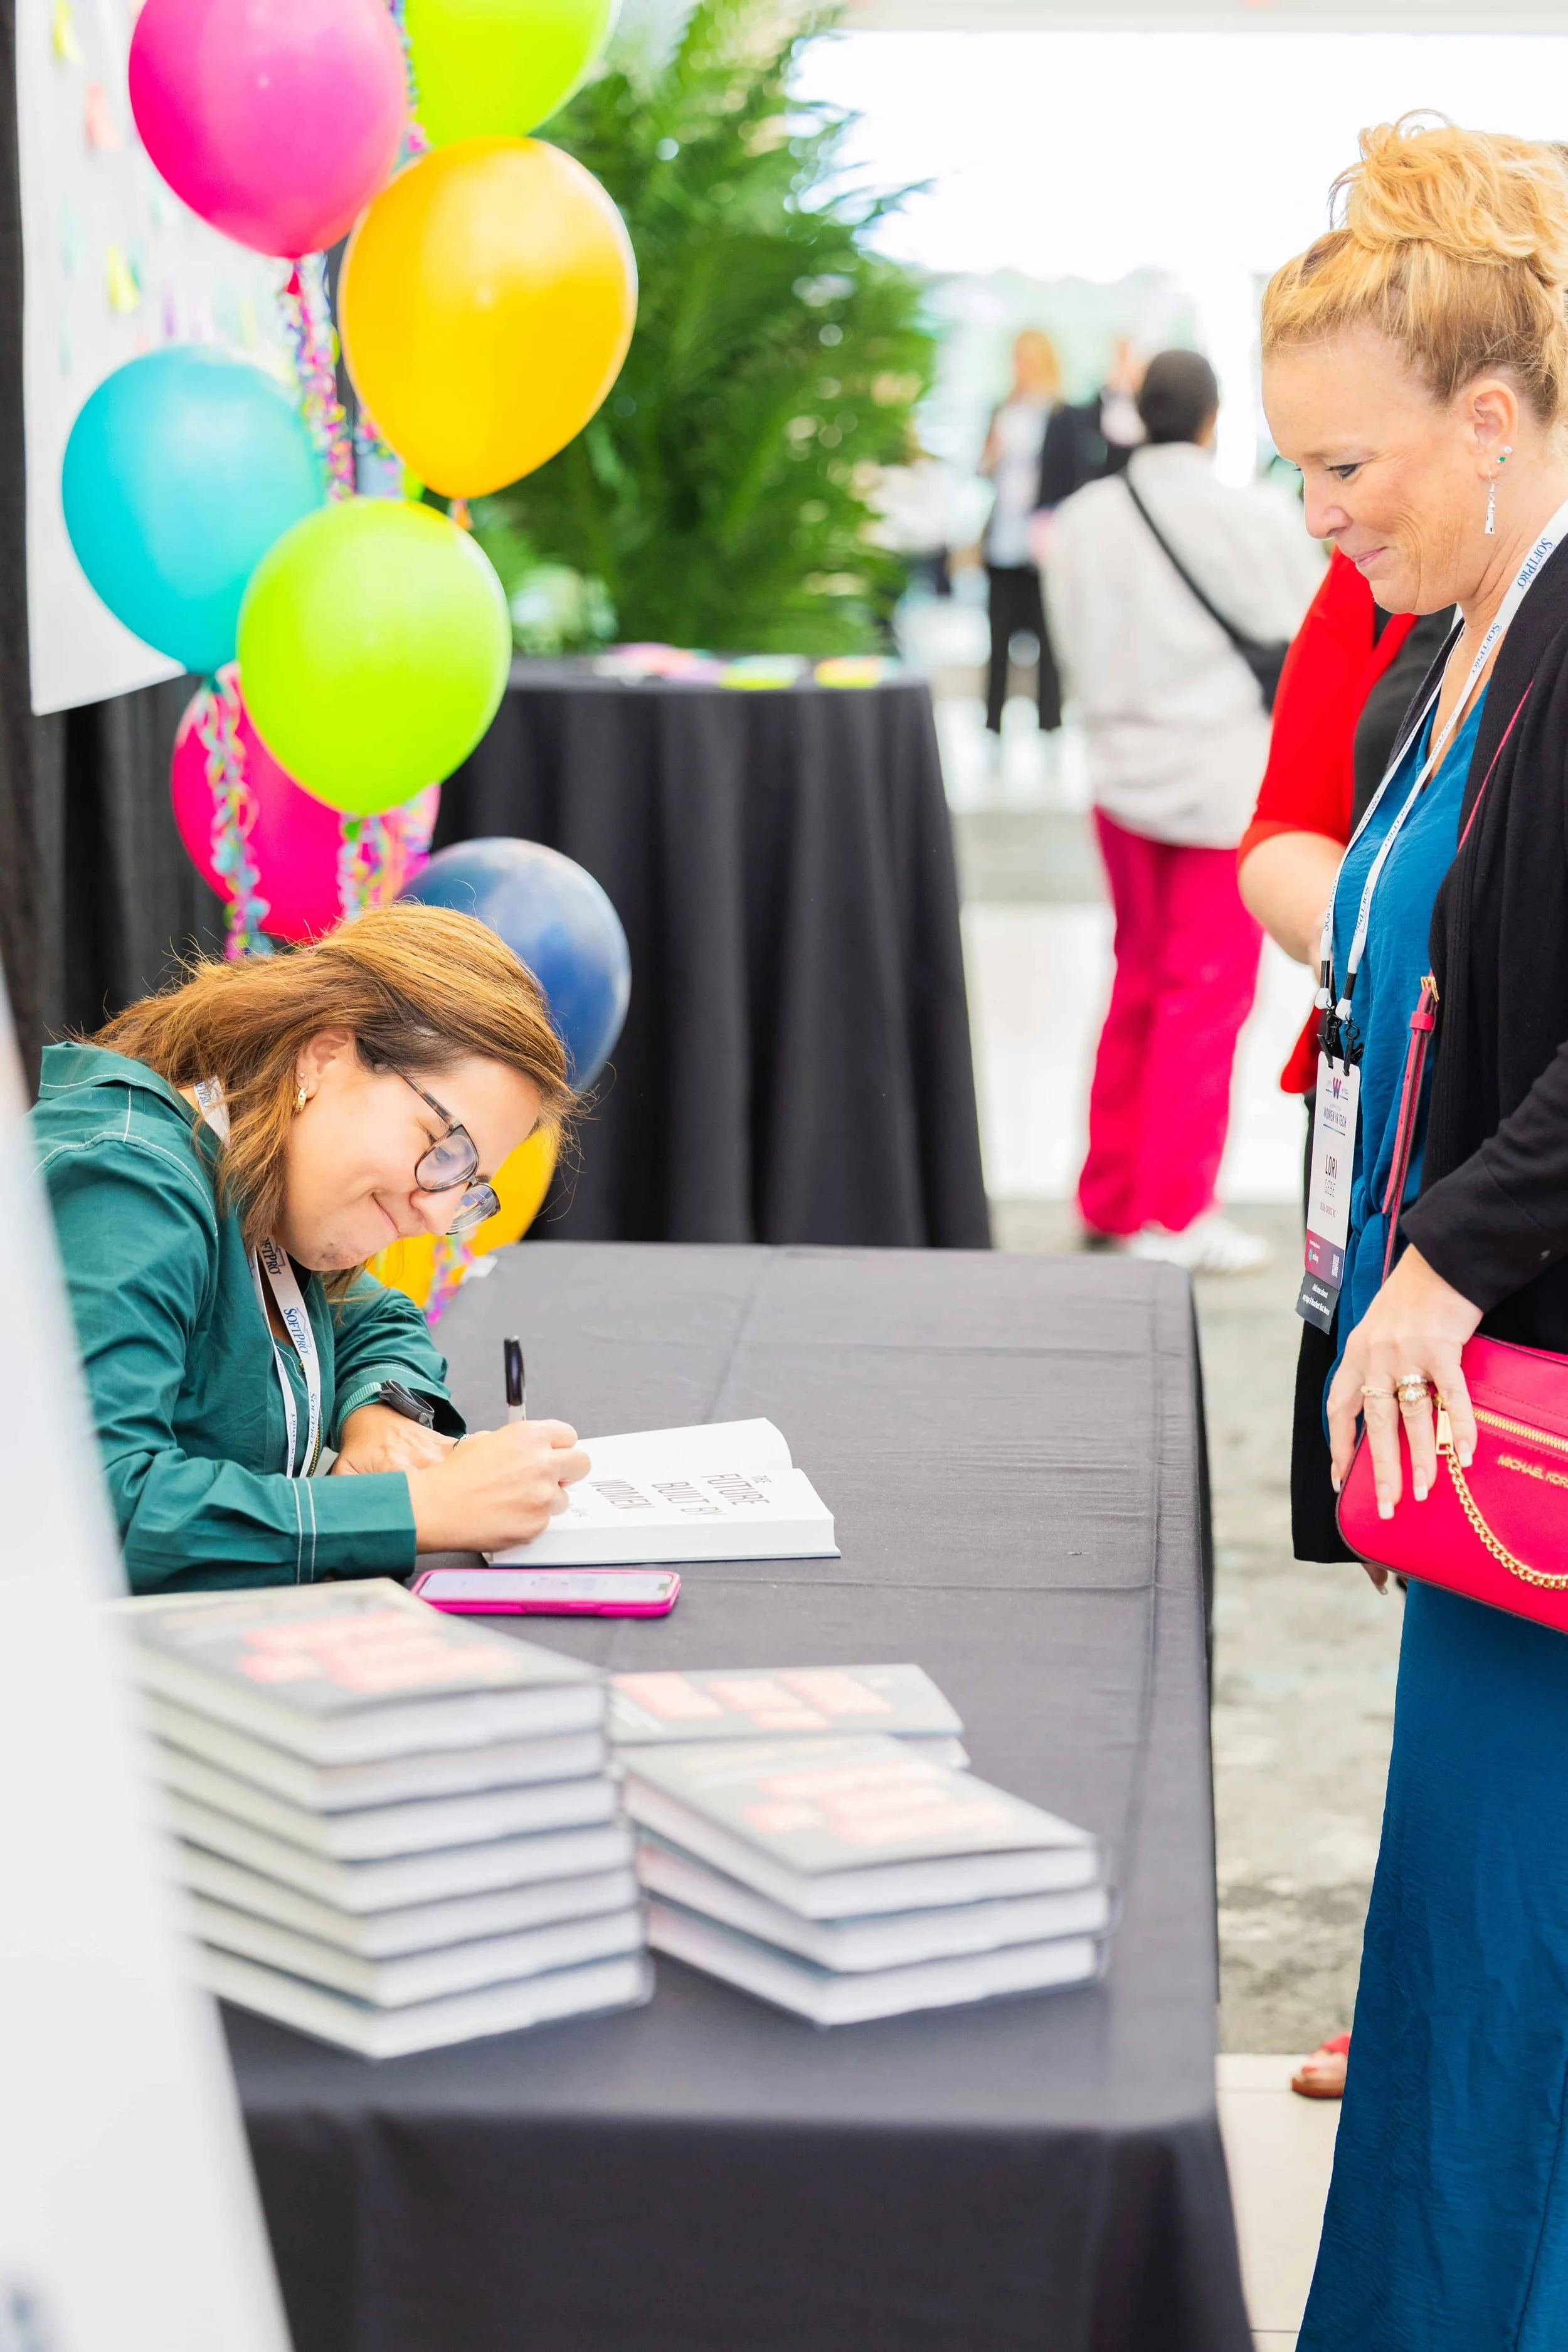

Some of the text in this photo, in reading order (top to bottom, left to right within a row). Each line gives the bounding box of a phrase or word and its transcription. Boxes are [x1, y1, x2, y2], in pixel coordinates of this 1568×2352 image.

[1517, 538, 1554, 589] SOFTPRO
[1471, 623, 1500, 674] SOFTPRO
[1333, 1076, 1342, 1099] W
[1323, 1106, 1335, 1122] WOMEN
[1338, 1114, 1347, 1128] TECH
[1325, 1154, 1337, 1179] LORI
[283, 1308, 309, 1355] SOFTPRO
[751, 1475, 772, 1484] THE
[1498, 1454, 1544, 1480] MICHAEL
[588, 1479, 656, 1509] WOMEN
[651, 1481, 728, 1516] BUILT BY
[701, 1473, 771, 1505] FUTURE
